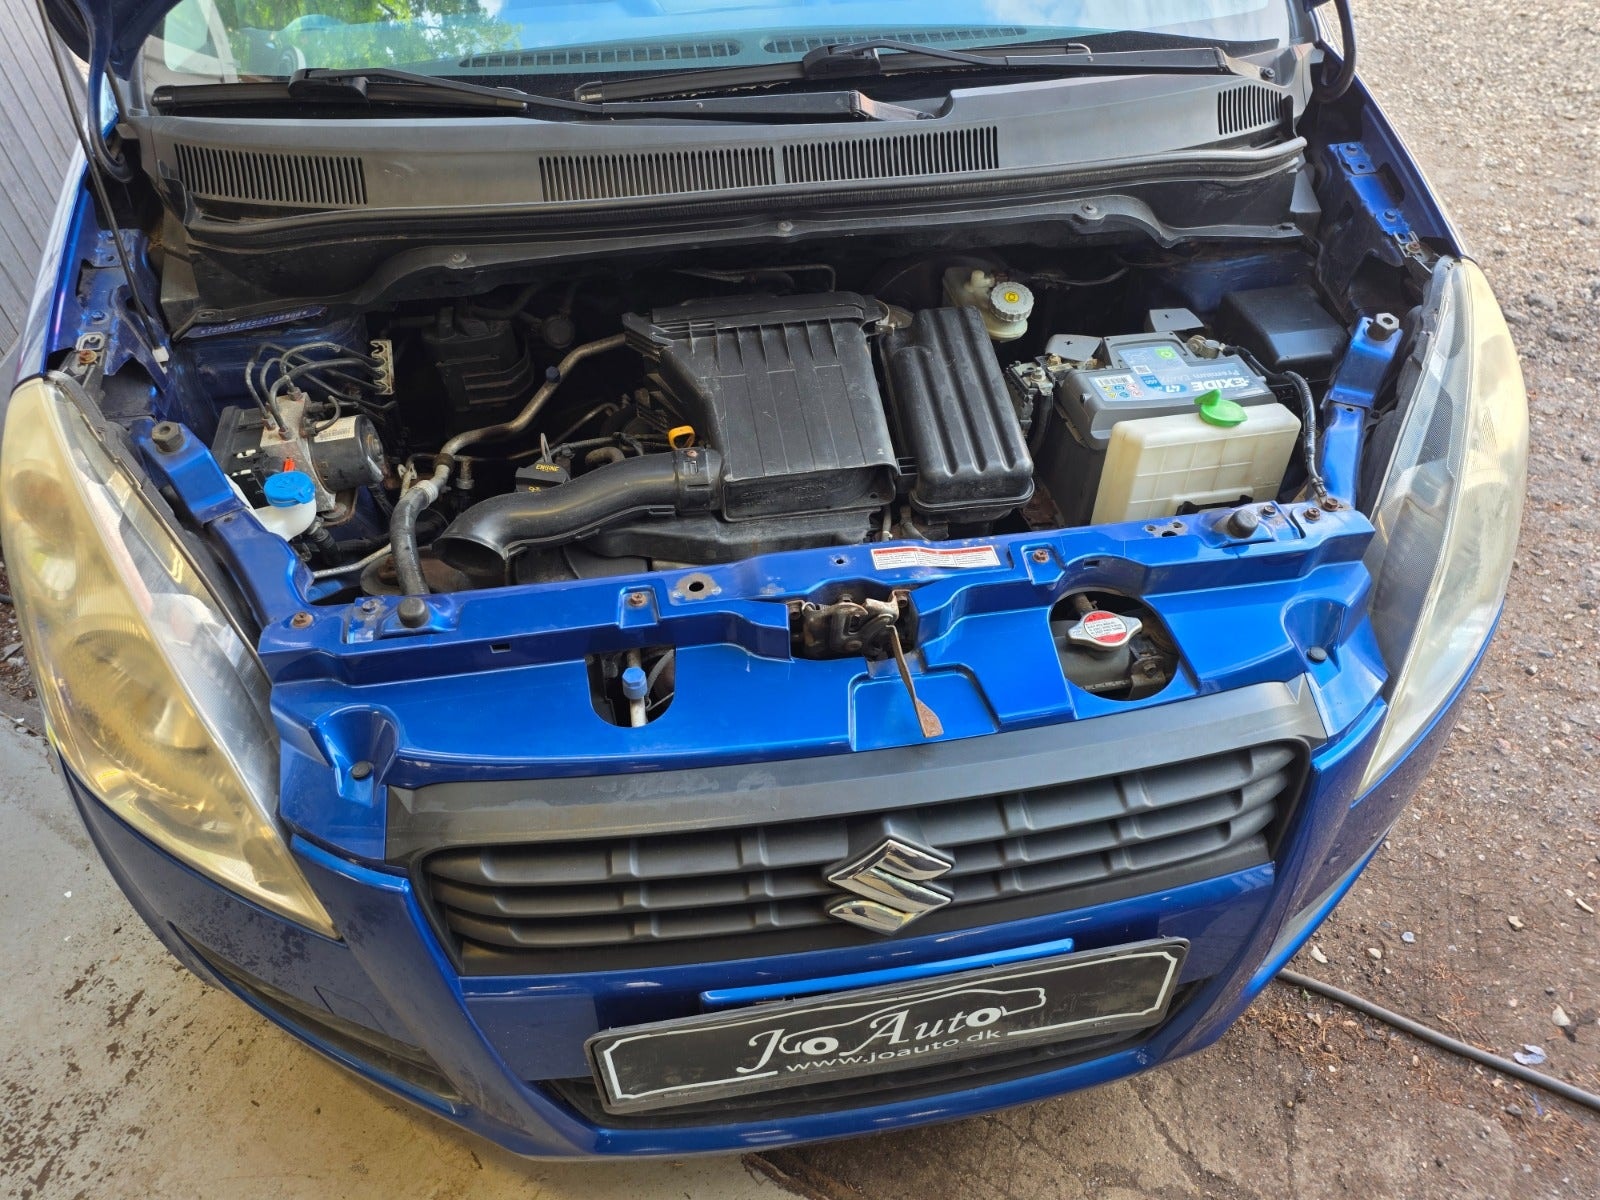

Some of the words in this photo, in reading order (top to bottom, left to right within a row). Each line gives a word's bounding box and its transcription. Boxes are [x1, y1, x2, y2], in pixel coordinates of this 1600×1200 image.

[1191, 377, 1247, 392] EXIDE
[535, 464, 559, 472] ENGINE
[839, 1009, 1002, 1056] Auto
[786, 1029, 1001, 1072] www.joauto.dk
